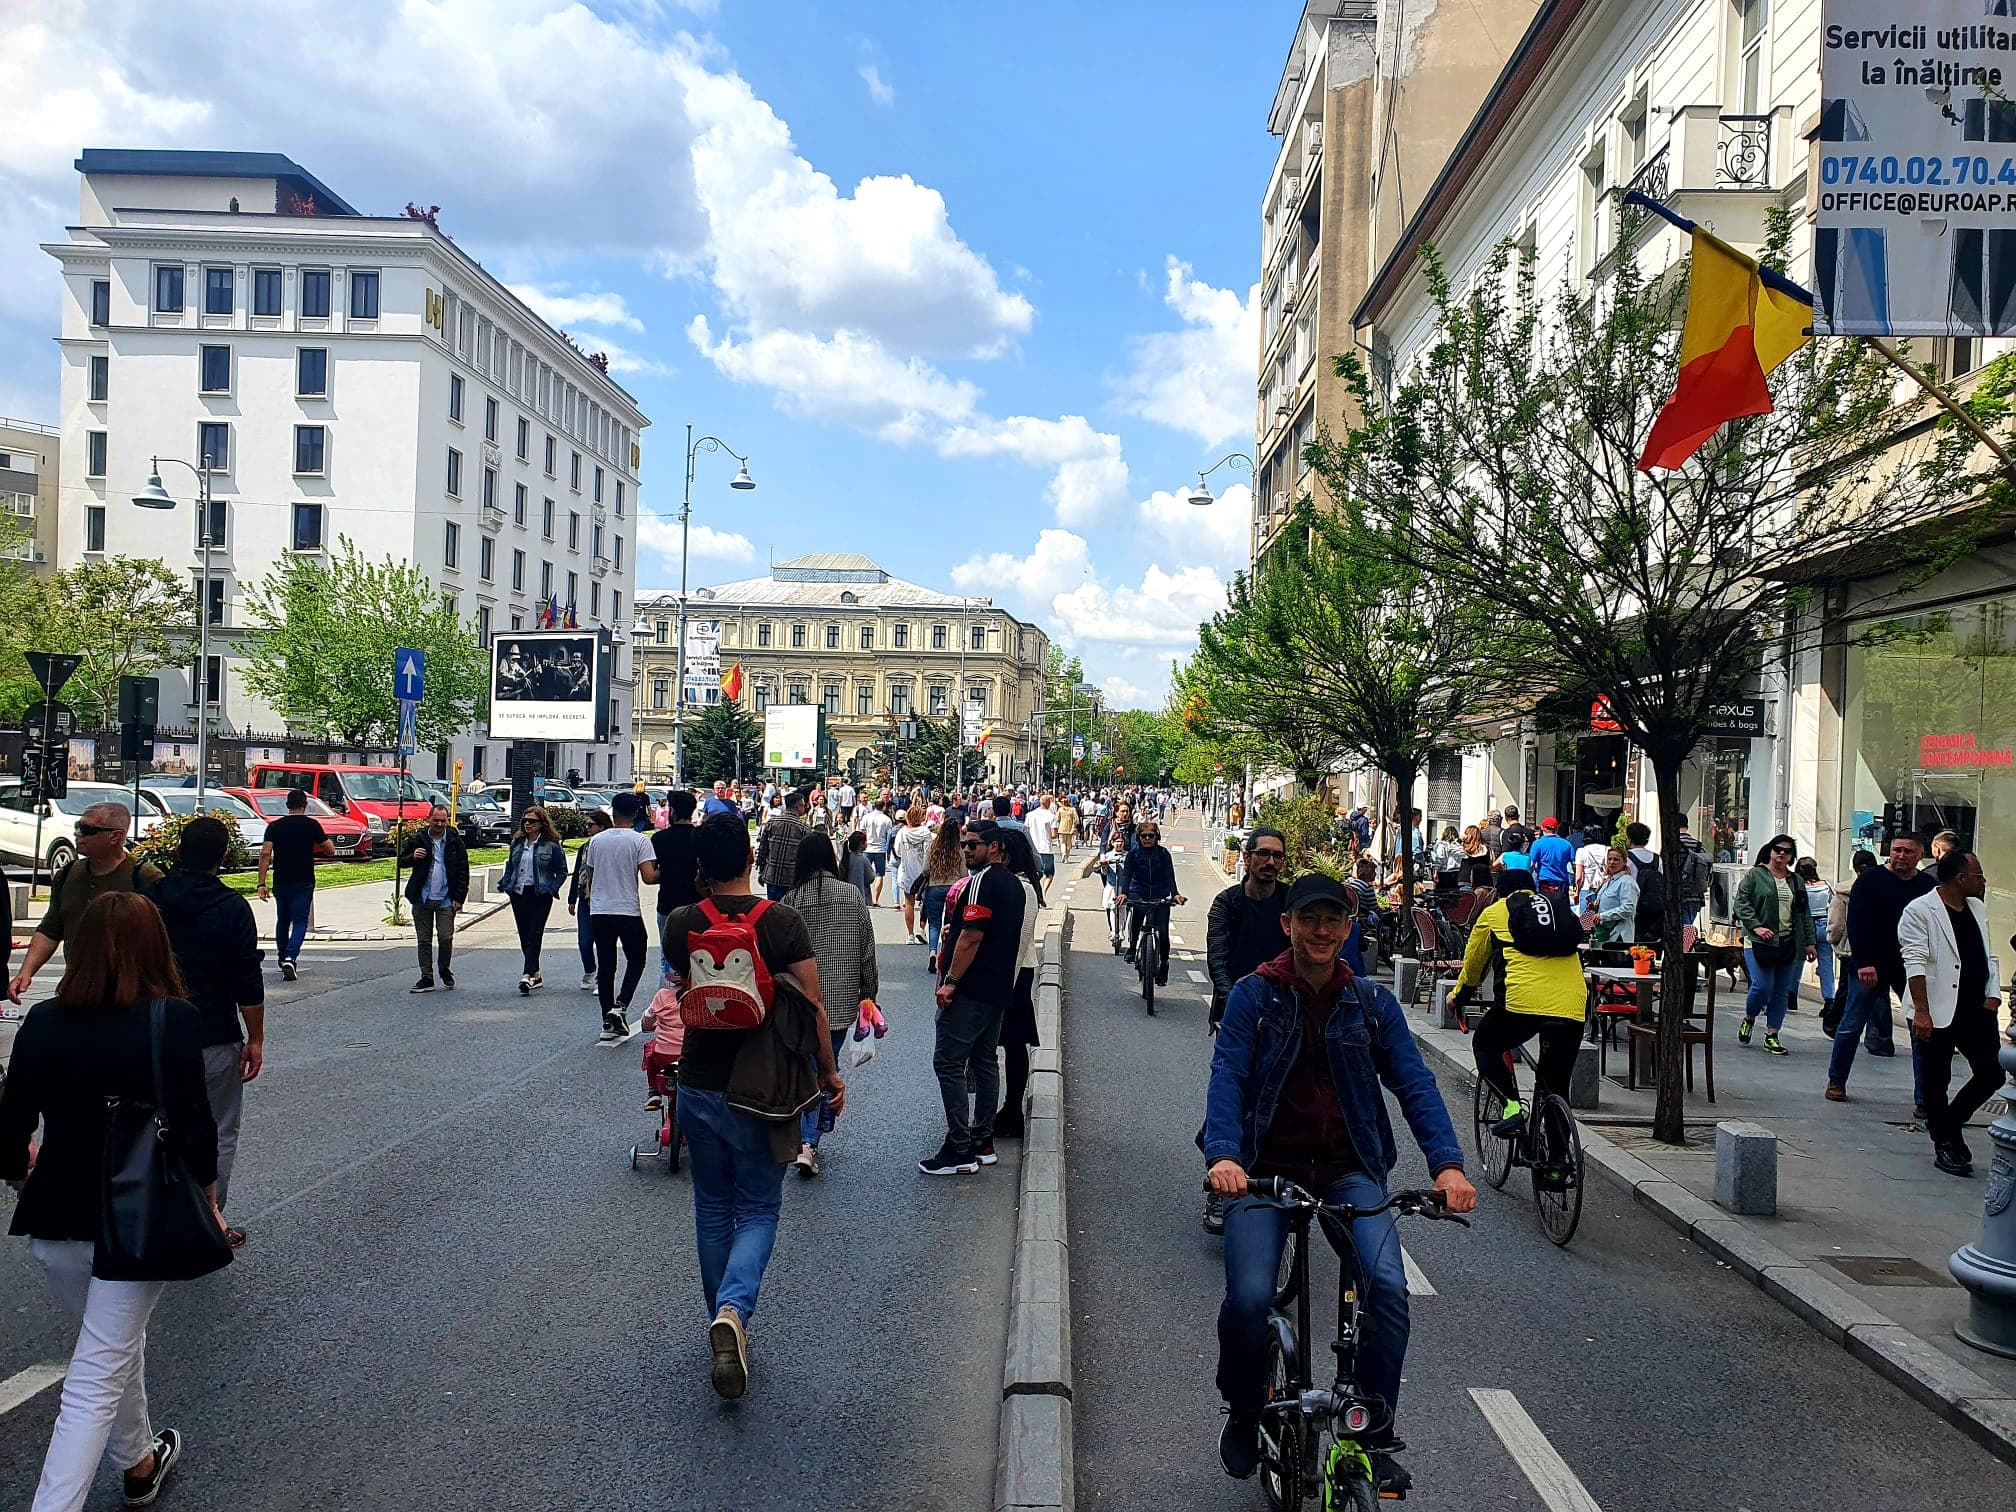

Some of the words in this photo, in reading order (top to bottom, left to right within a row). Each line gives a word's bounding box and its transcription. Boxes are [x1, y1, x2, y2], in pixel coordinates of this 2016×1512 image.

[1826, 24, 1926, 50] Servicii
[1862, 60, 1885, 85] la
[1709, 704, 1754, 716] nexus
